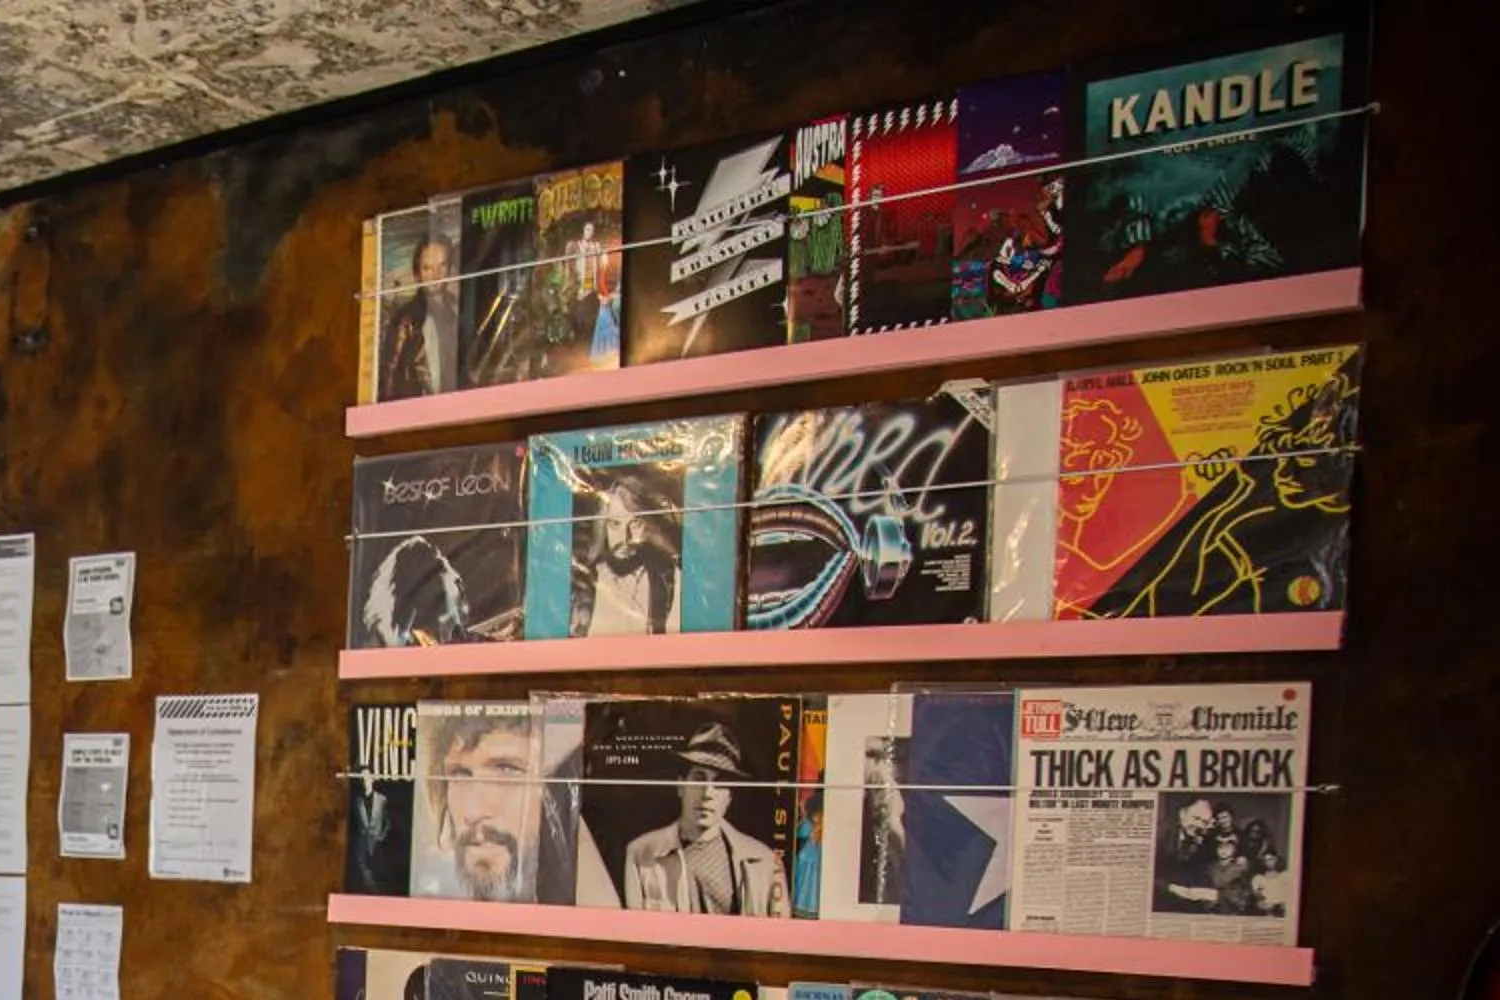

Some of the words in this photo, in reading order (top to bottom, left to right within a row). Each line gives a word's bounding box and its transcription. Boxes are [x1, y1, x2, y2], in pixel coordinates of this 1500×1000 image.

[1110, 60, 1322, 140] KANDLE
[1141, 370, 1171, 384] JOHN
[1173, 366, 1210, 381] OATES
[1215, 362, 1249, 377] ROCK
[1265, 356, 1296, 371] SOUL
[1300, 352, 1332, 367] PART
[1023, 714, 1060, 733] TULL
[1192, 705, 1298, 732] Chronicle
[357, 706, 416, 782] VINC
[1030, 749, 1115, 788] THICK
[1123, 749, 1162, 788] AS
[1168, 750, 1189, 788] A
[1199, 749, 1295, 788] BRICK
